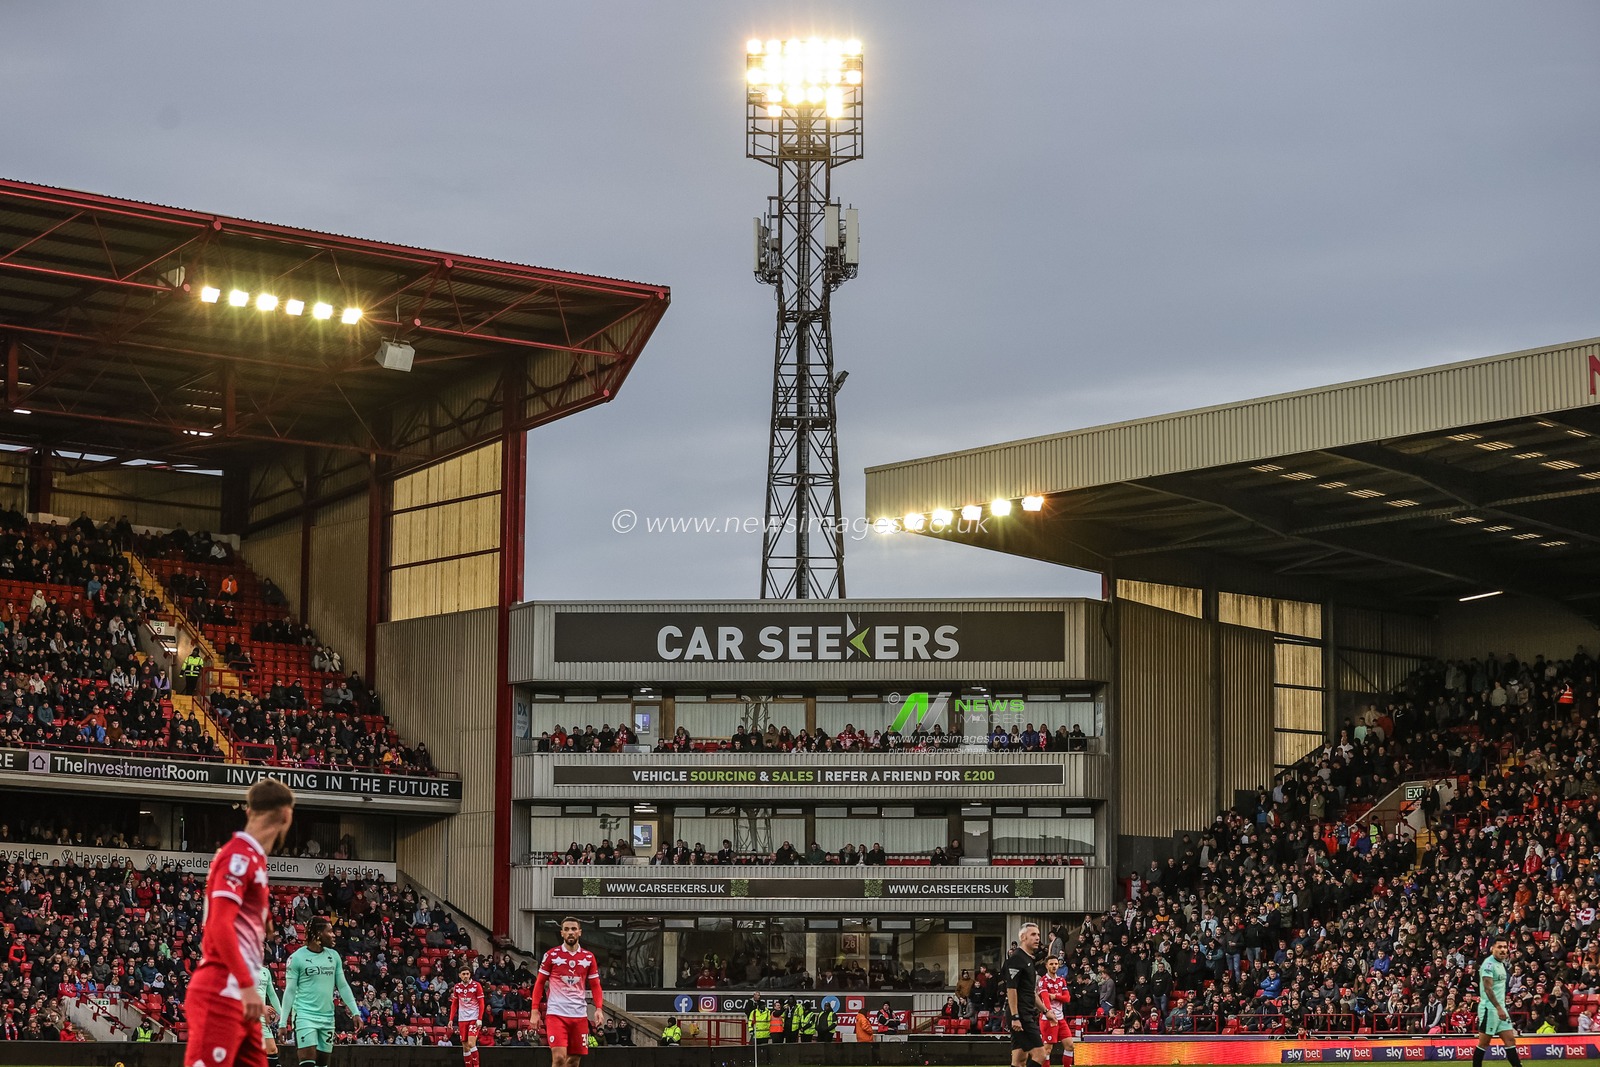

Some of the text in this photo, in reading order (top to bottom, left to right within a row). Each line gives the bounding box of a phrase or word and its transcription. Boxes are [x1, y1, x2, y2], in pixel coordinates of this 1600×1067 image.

[657, 613, 960, 660] CAR SEEKERS
[54, 756, 209, 781] TheInvestmentRoom
[226, 768, 449, 797] INVESTING IN THE FUTURE
[632, 771, 687, 782] VEHICLE
[690, 771, 756, 782] SOURCING
[759, 771, 769, 782] &
[772, 771, 814, 782] SALES
[825, 771, 867, 782] REFER
[871, 771, 880, 781] A
[883, 771, 932, 781] FRIEND
[935, 771, 960, 781] FOR
[963, 771, 995, 781] £200
[1407, 788, 1424, 798] EXI
[0, 848, 49, 861] ayselden
[266, 861, 299, 873] selden
[606, 883, 725, 894] WWW.CARSEEKERS.UK
[888, 884, 1010, 895] WWW.CARSEEKERS.UK
[1287, 1049, 1321, 1061] sky bet
[1335, 1048, 1371, 1060] sky bet
[1386, 1047, 1423, 1060] sky bet
[1437, 1047, 1455, 1058] sky
[1546, 1045, 1585, 1058] sky bet
